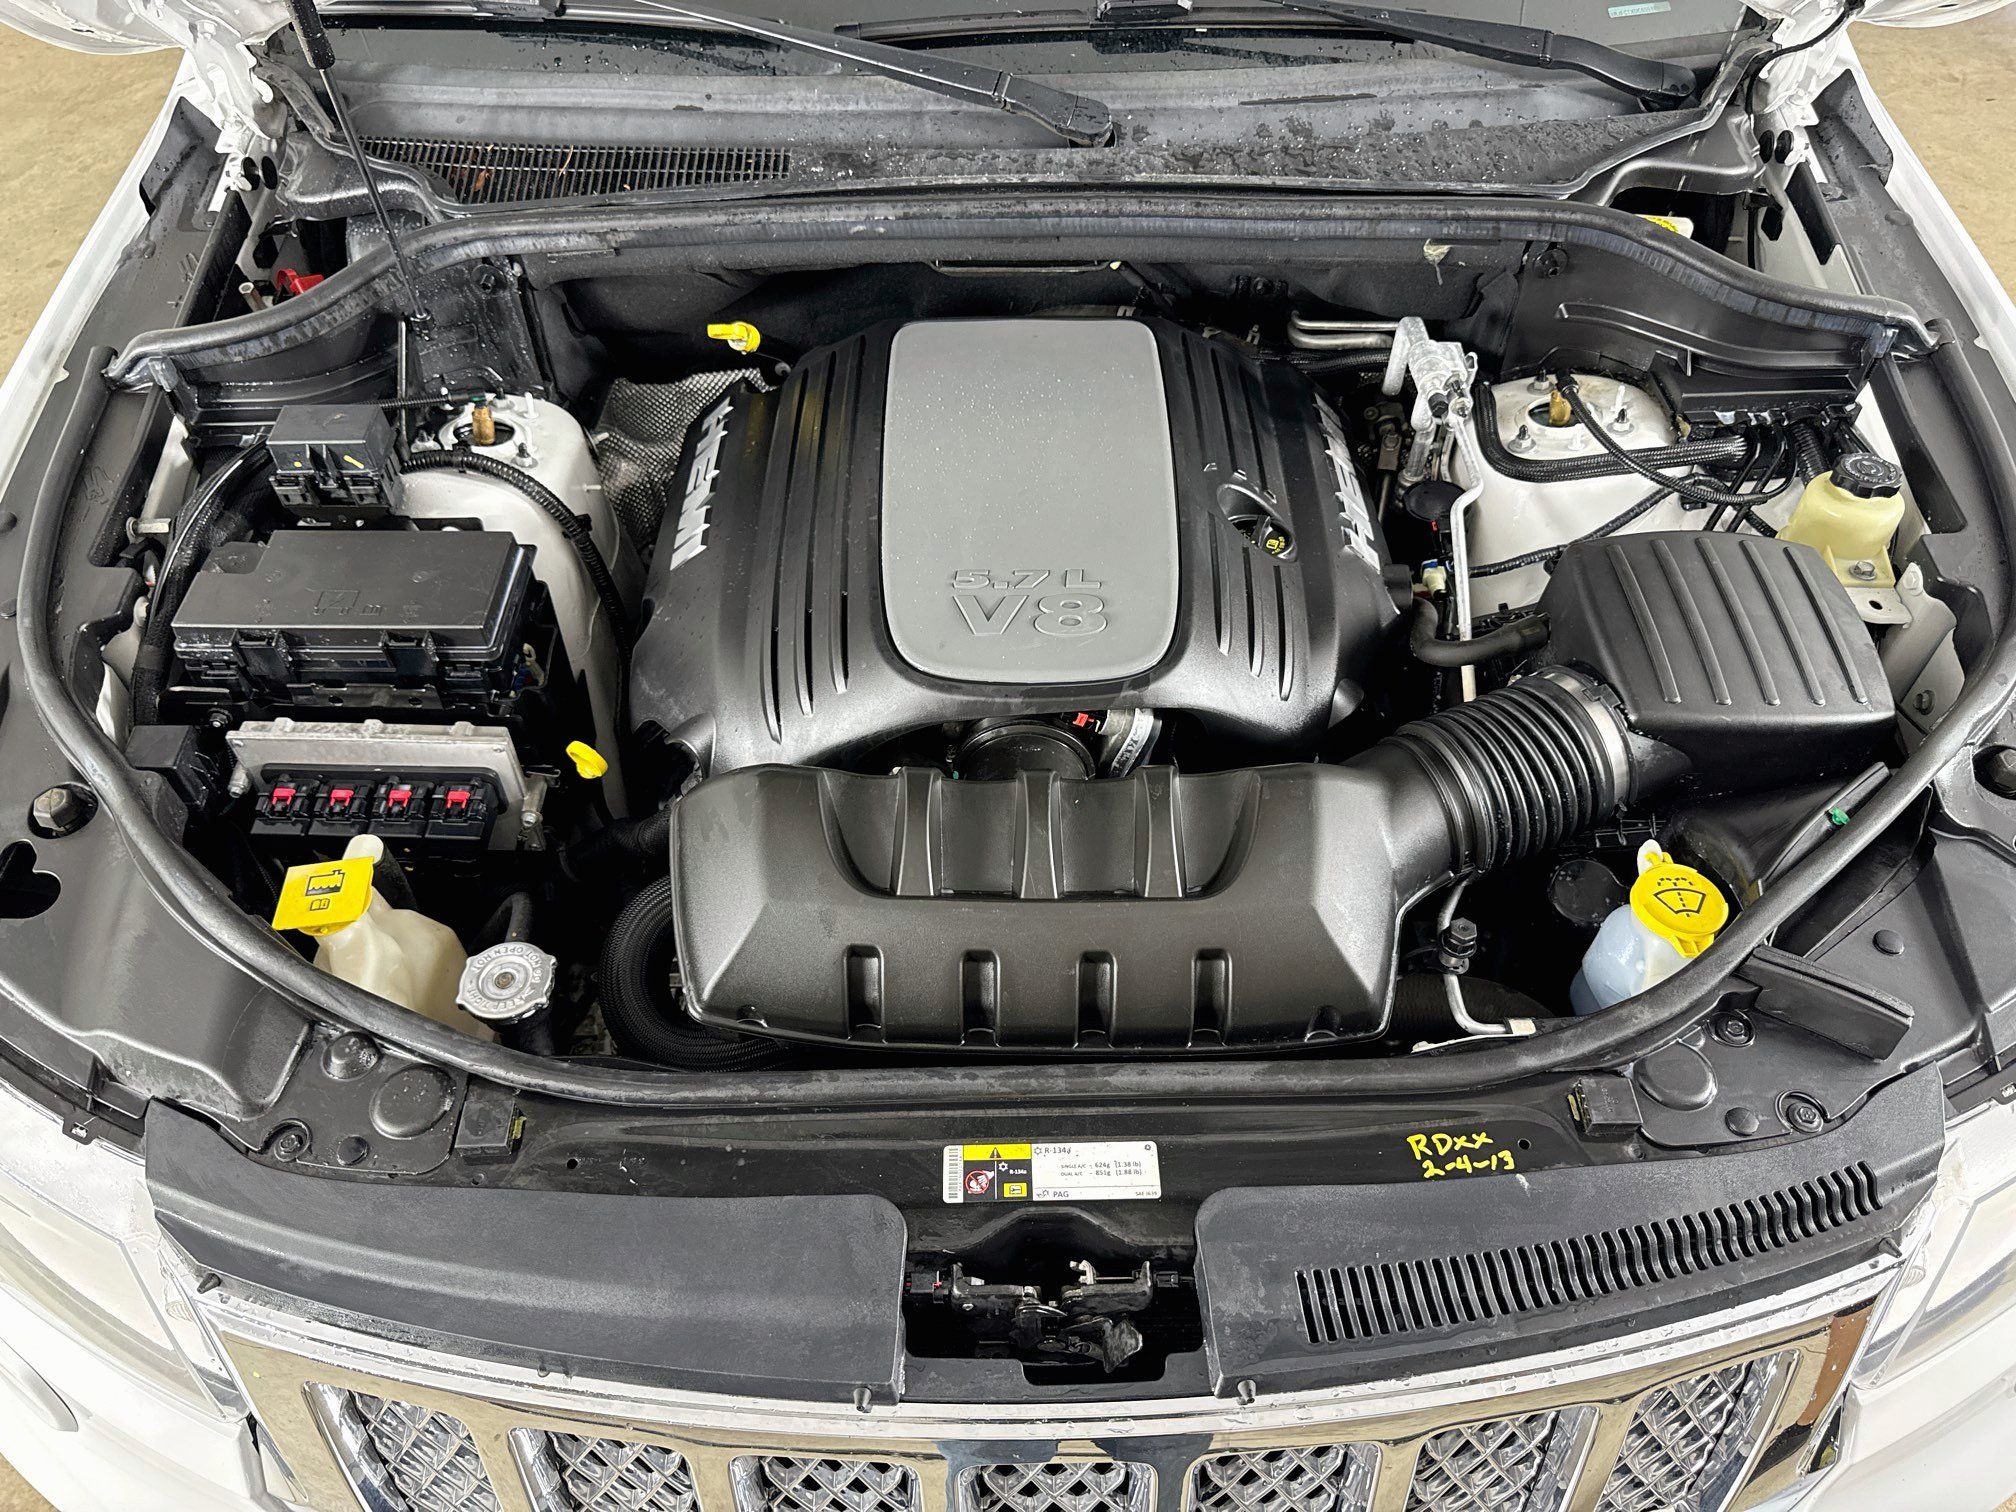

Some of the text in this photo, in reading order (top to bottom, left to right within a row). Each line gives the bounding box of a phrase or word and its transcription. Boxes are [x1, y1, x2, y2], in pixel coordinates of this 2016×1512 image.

[670, 396, 733, 571] HEMI
[1313, 392, 1381, 574] HEMI
[952, 568, 1101, 589] 5.7 L
[952, 593, 1108, 637] V8
[494, 946, 524, 955] OPEN
[525, 951, 543, 968] NOT
[471, 954, 492, 972] HOT
[466, 988, 524, 1010] KEEP TIGHT
[1094, 1161, 1111, 1169] 624g
[1421, 1149, 1515, 1178] 2-4-13
